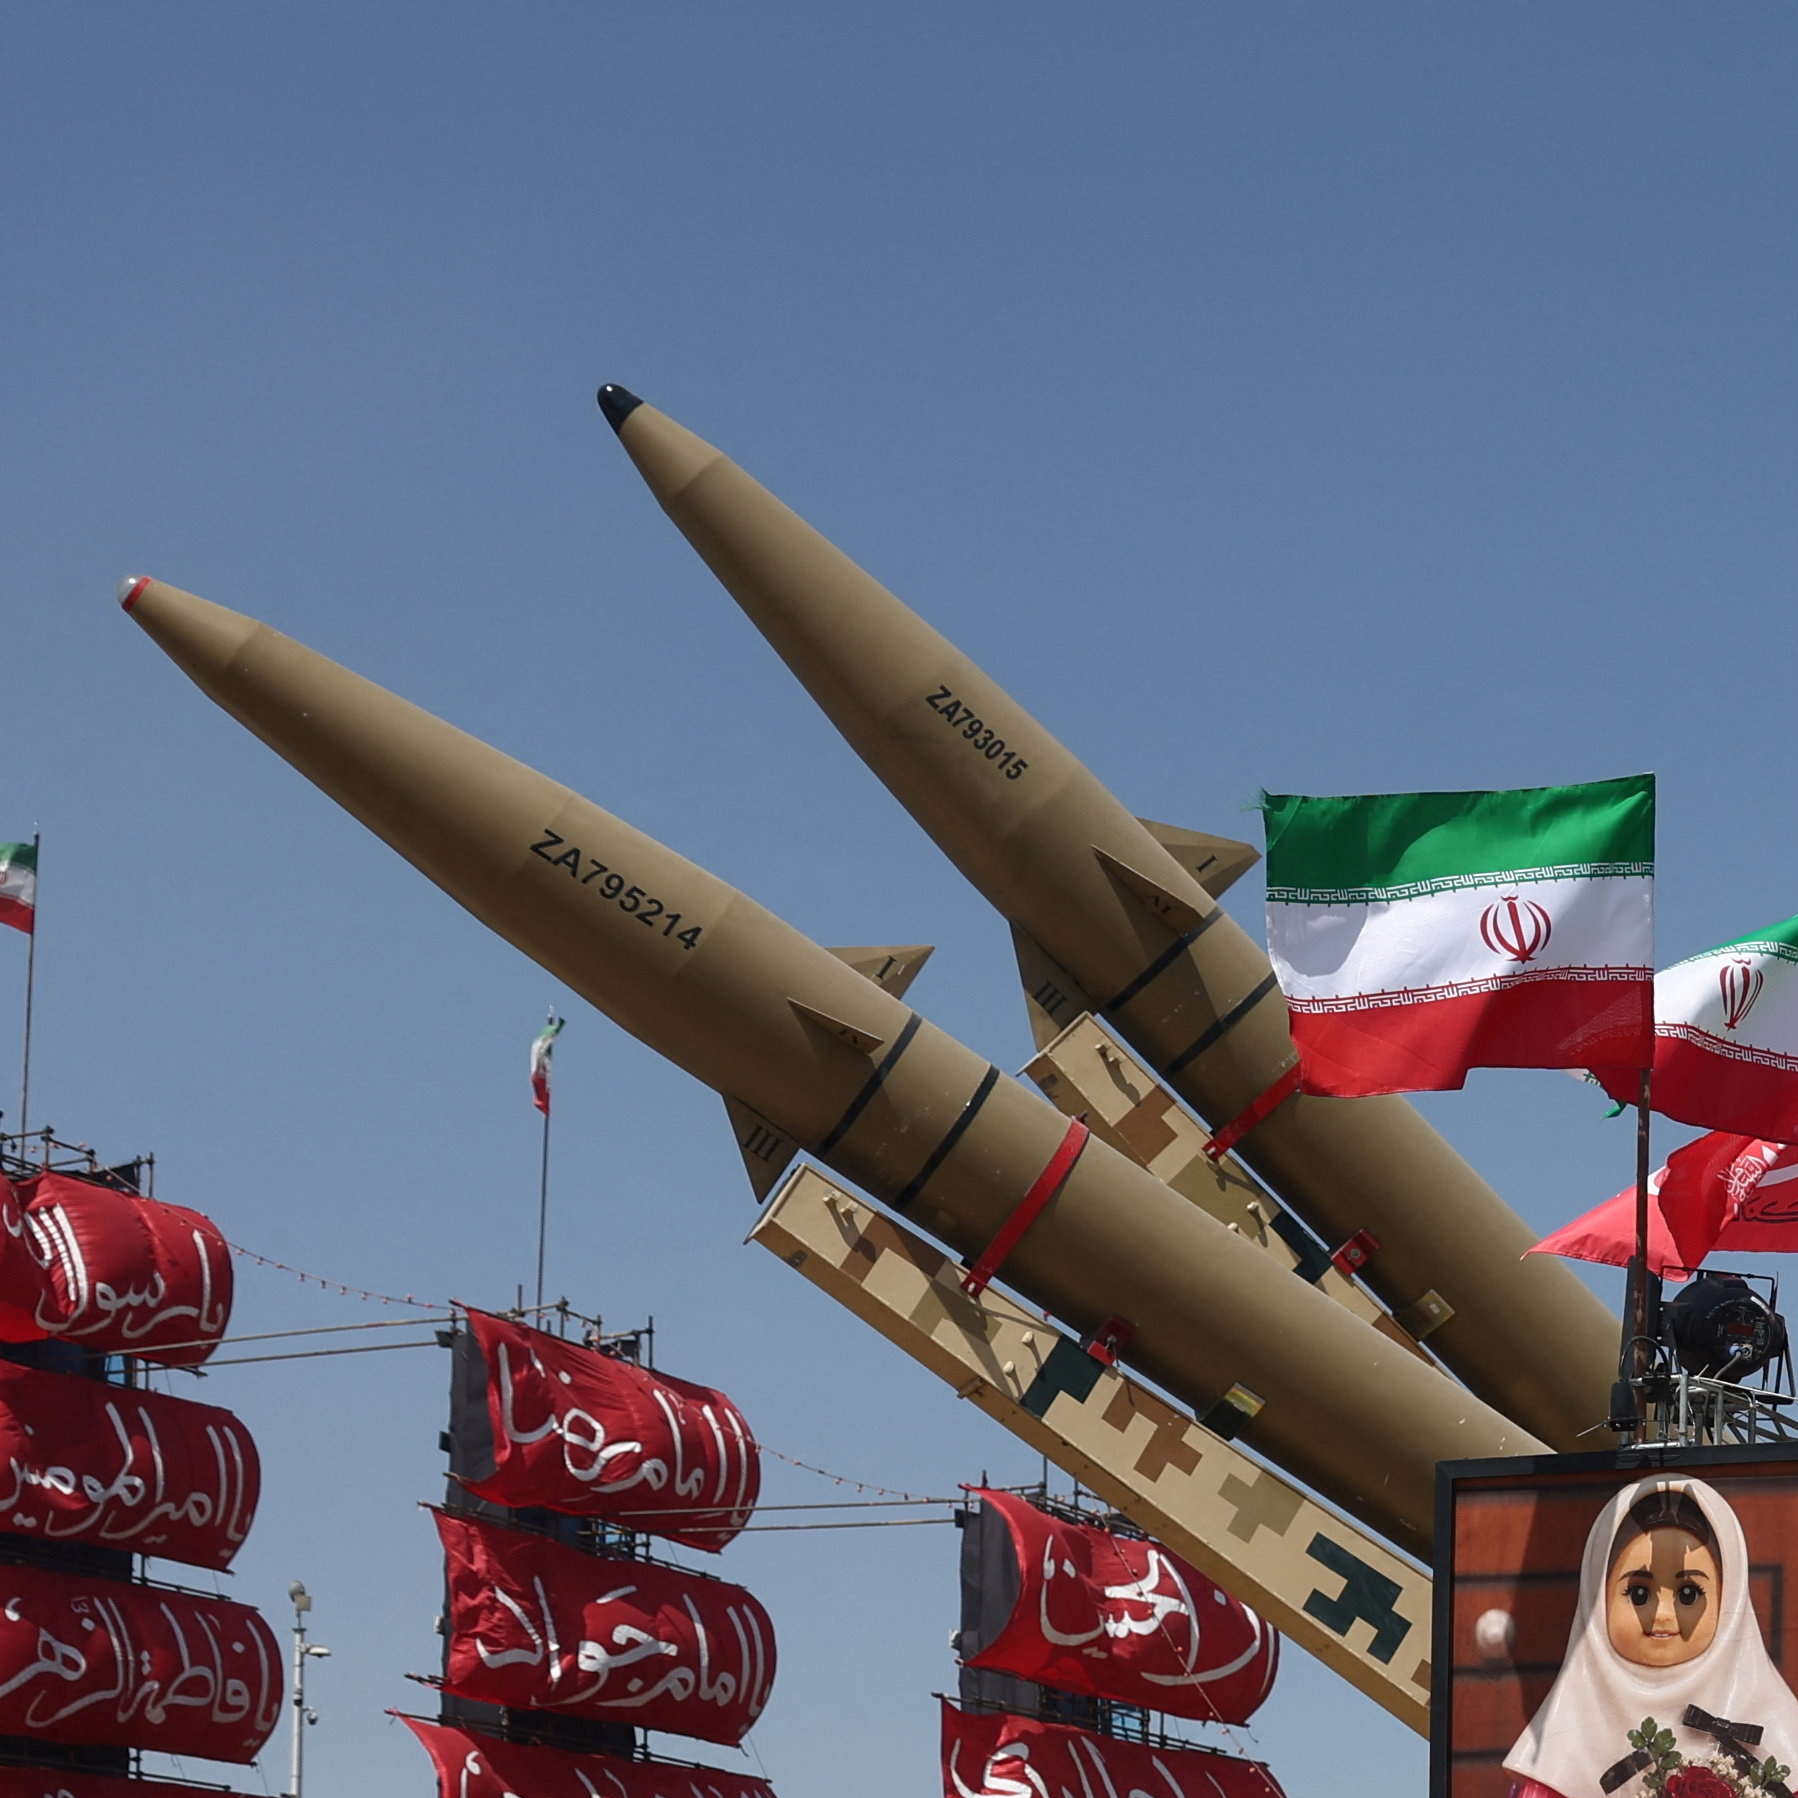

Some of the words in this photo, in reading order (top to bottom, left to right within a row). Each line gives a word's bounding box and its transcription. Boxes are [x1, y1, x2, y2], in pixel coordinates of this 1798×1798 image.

[925, 685, 1028, 780] ZA793015
[530, 829, 703, 950] ZA795214
[742, 1123, 782, 1162] III
